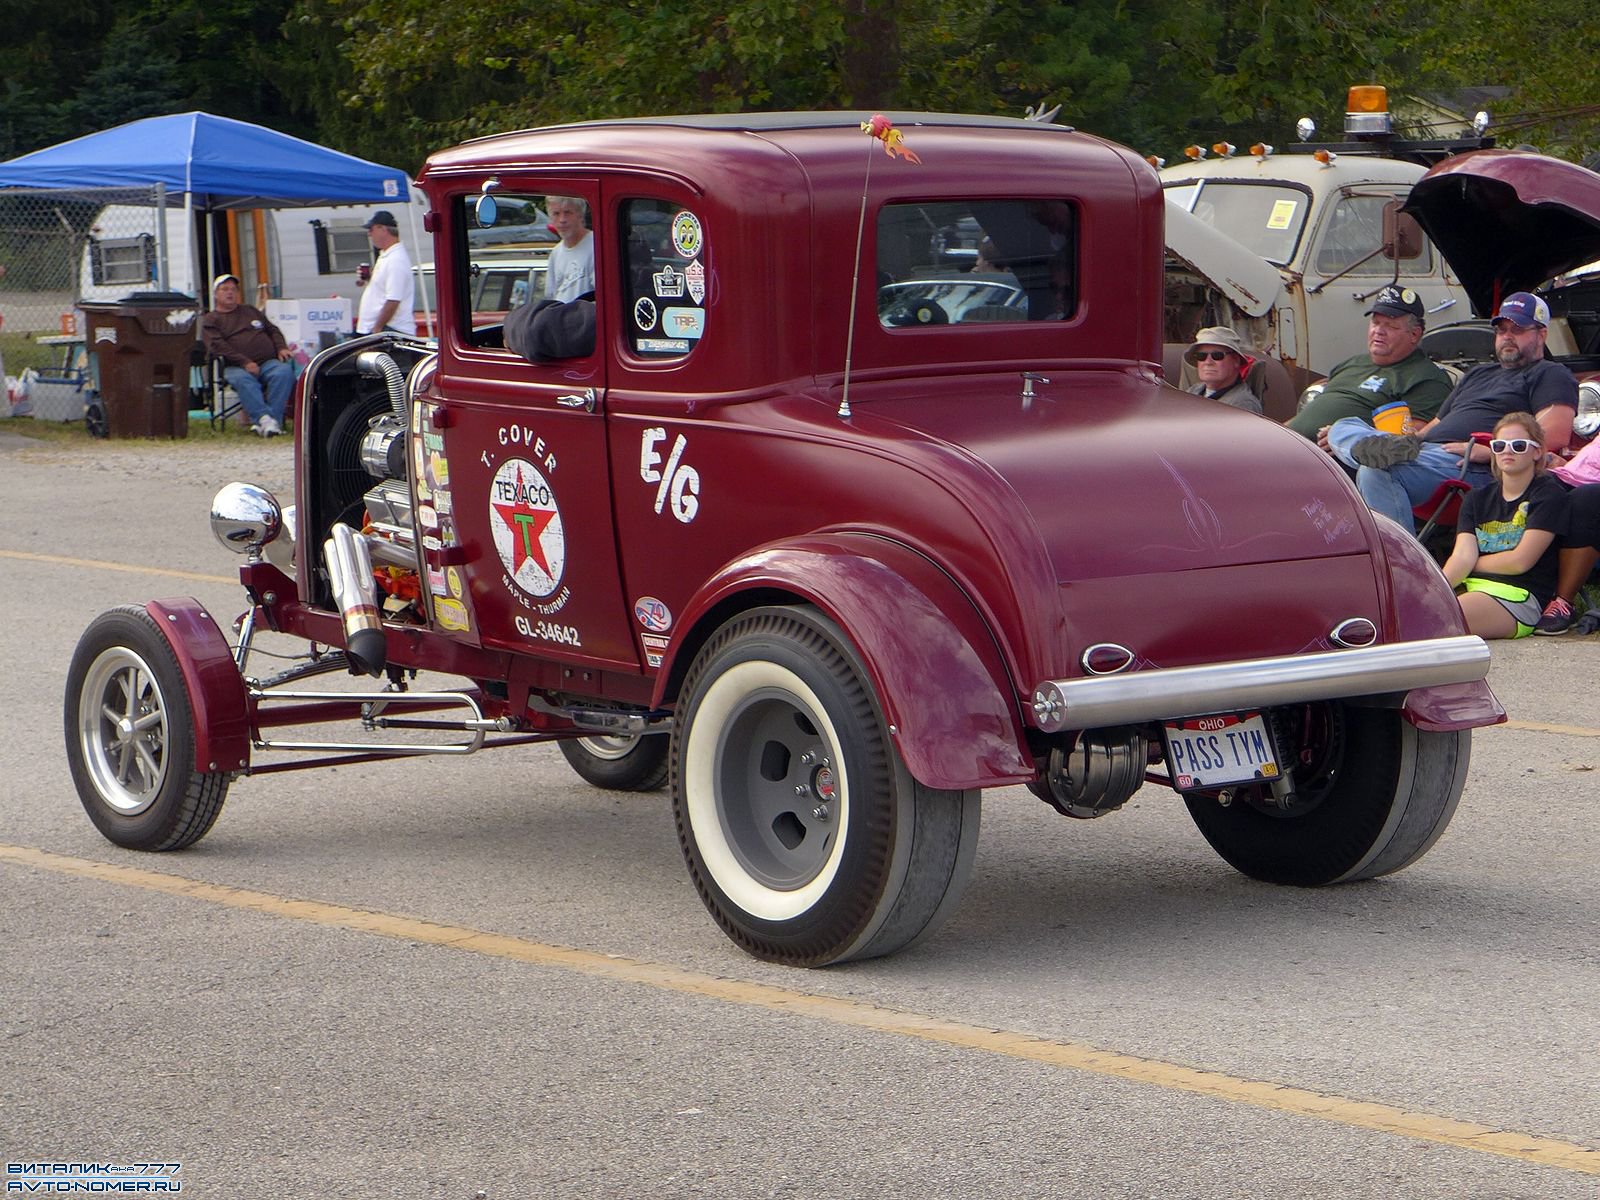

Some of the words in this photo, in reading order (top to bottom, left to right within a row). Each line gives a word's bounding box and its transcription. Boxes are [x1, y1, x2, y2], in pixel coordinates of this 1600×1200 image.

[307, 310, 344, 321] GILDAN
[498, 424, 557, 474] COVER
[495, 480, 549, 506] TEXACO
[640, 427, 700, 524] E/G
[513, 513, 535, 558] T
[501, 574, 530, 609] MAPLE
[538, 585, 571, 616] THURMAN
[514, 614, 582, 648] GL-34642
[1198, 717, 1226, 731] OHIO
[1170, 734, 1225, 774] PASS
[1225, 729, 1269, 767] TYM
